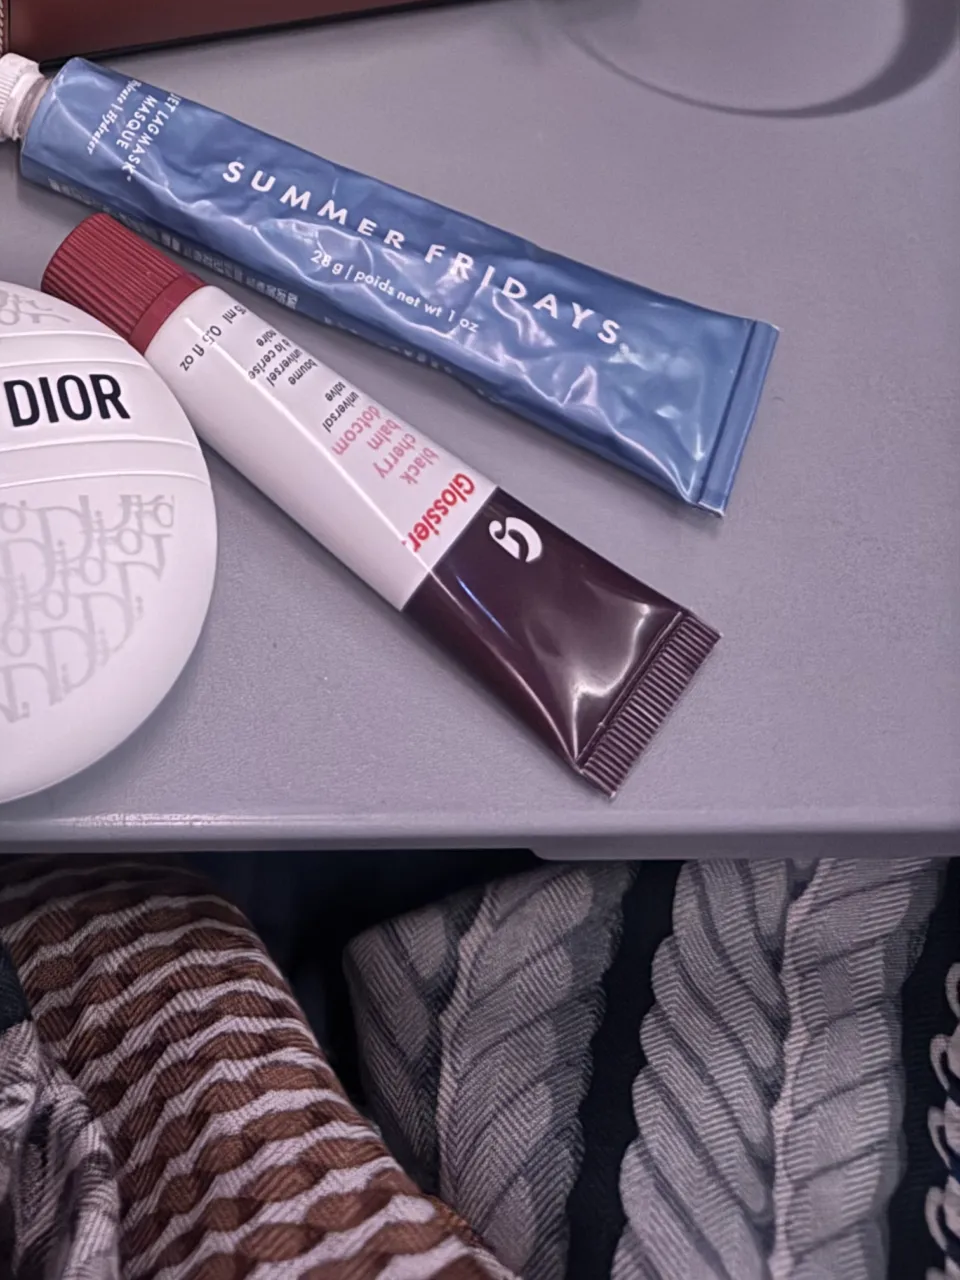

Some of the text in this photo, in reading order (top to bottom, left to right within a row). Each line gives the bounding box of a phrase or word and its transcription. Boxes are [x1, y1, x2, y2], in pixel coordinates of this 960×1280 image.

[116, 95, 158, 150] MASQUE
[163, 92, 182, 113] JET
[147, 110, 169, 136] LAG
[222, 161, 406, 250] SUMMER
[424, 243, 621, 346] FRIDAYS
[222, 309, 237, 325] ml
[353, 270, 396, 297] poids
[396, 291, 421, 308] net
[424, 302, 442, 319] wt
[459, 318, 480, 334] oz
[179, 354, 194, 372] oz
[248, 351, 276, 380] cerise
[266, 348, 303, 388] universel
[288, 357, 319, 386] baume
[3, 374, 132, 428] DIOR
[321, 390, 359, 434] universal
[331, 404, 381, 457] dotcom
[367, 418, 403, 451] balm
[372, 432, 417, 480] cherry
[398, 446, 439, 486] black
